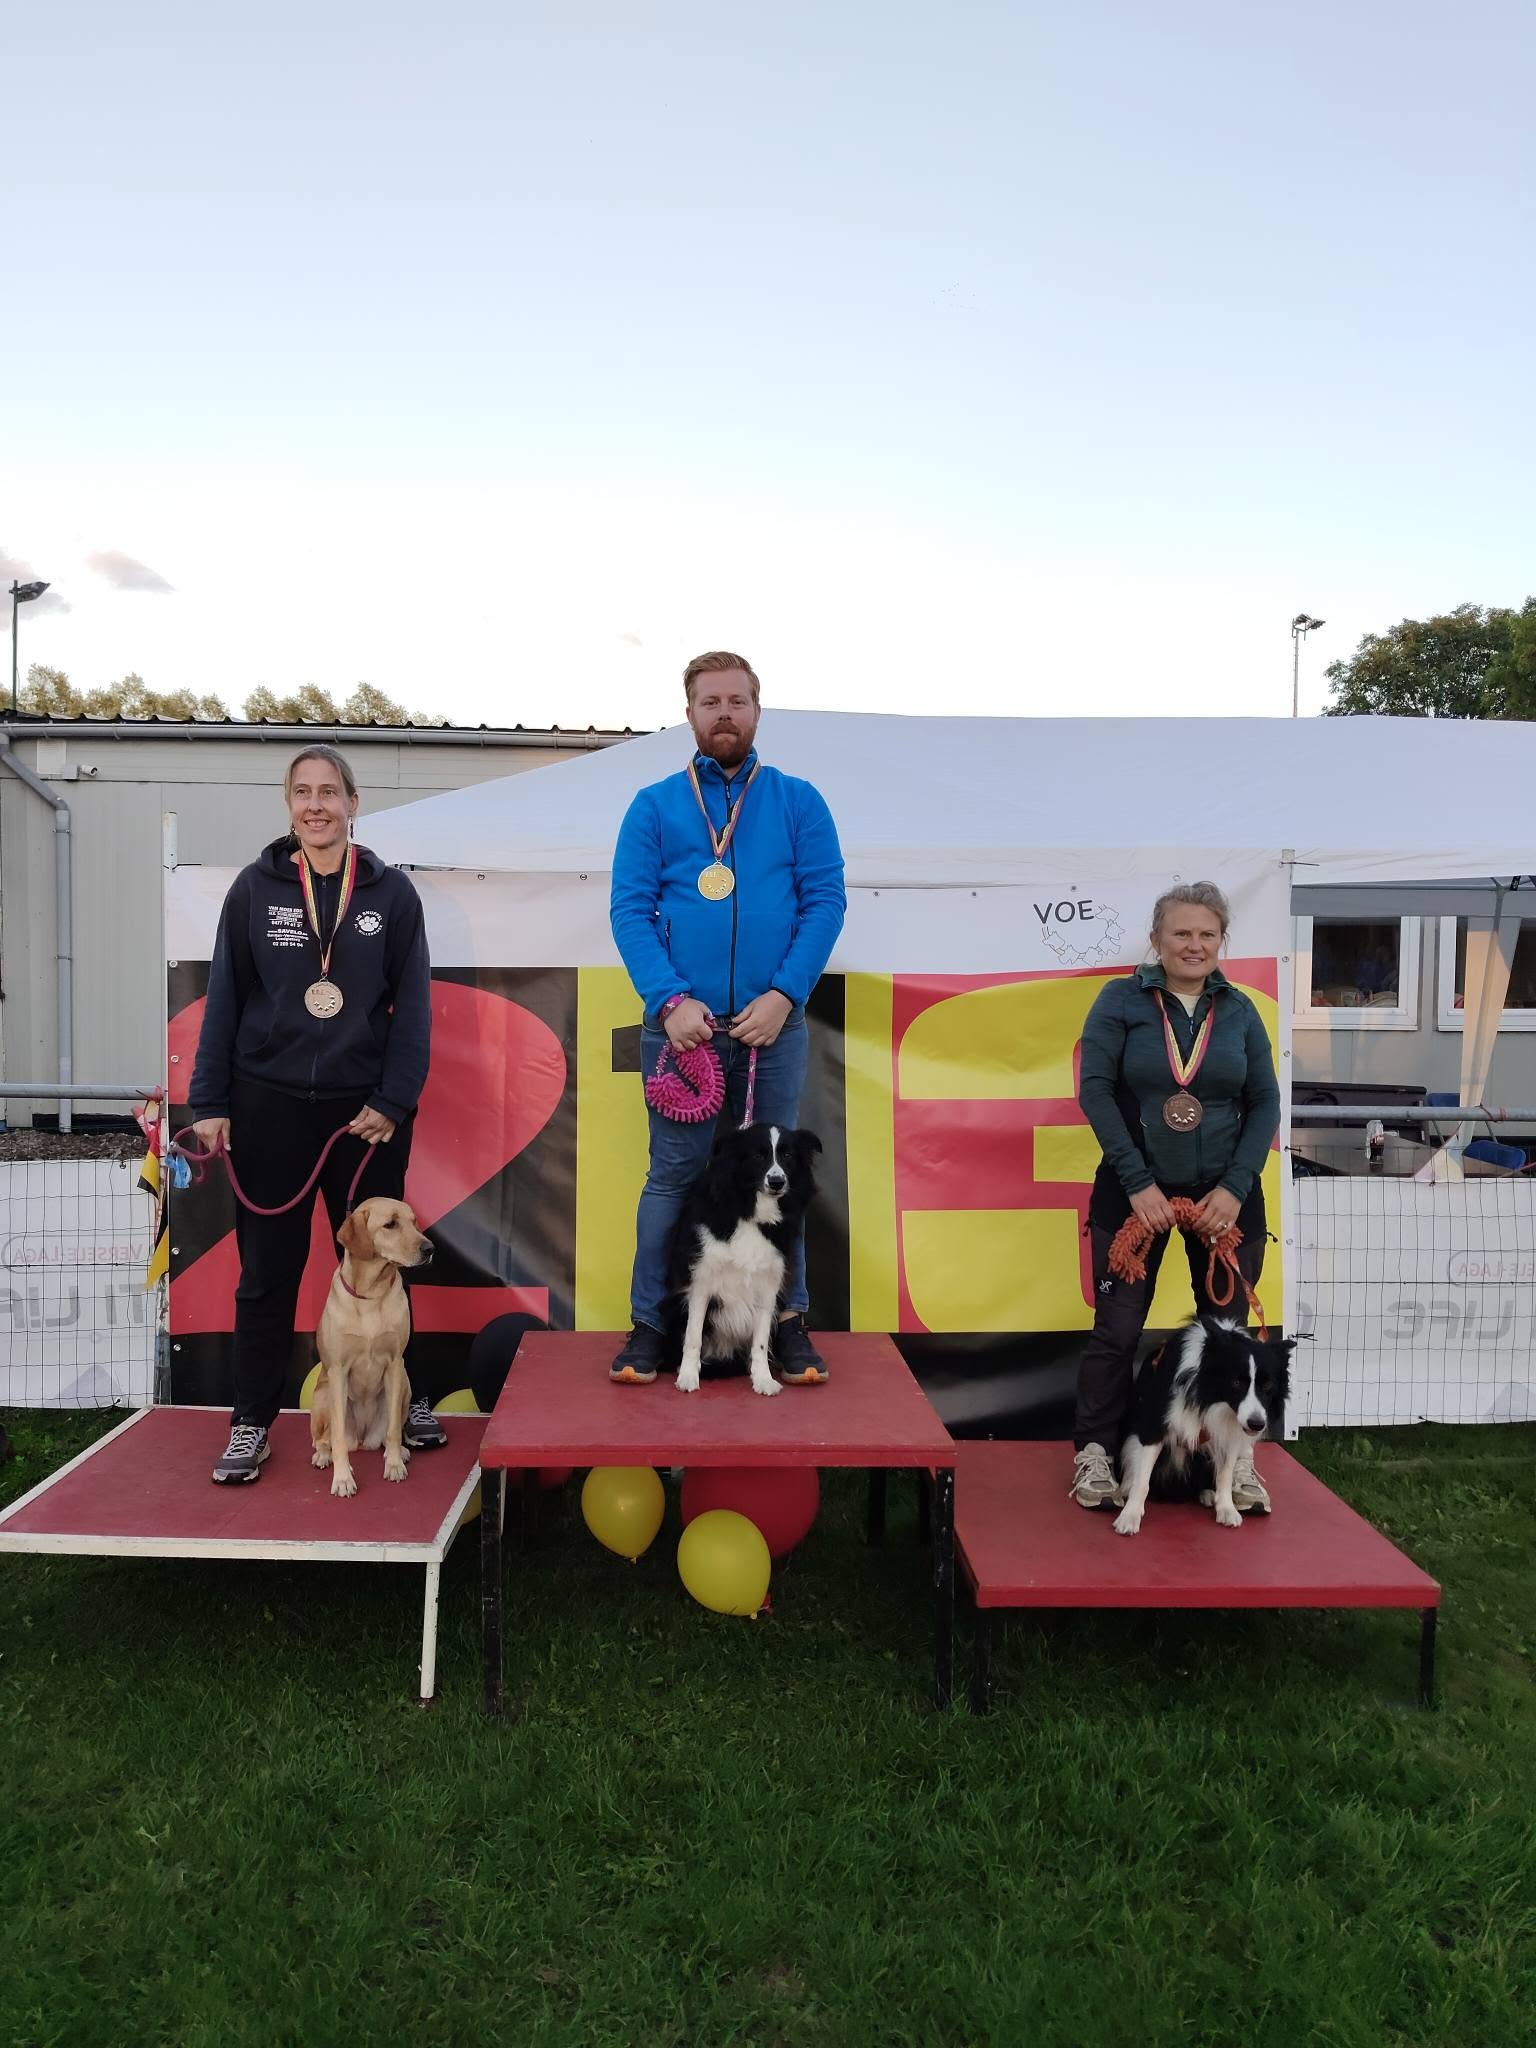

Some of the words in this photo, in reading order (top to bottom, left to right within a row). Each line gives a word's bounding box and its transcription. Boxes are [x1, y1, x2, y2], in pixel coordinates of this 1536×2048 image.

[1033, 899, 1095, 924] VOE
[168, 978, 568, 1335] 2
[898, 974, 1283, 1333] 3
